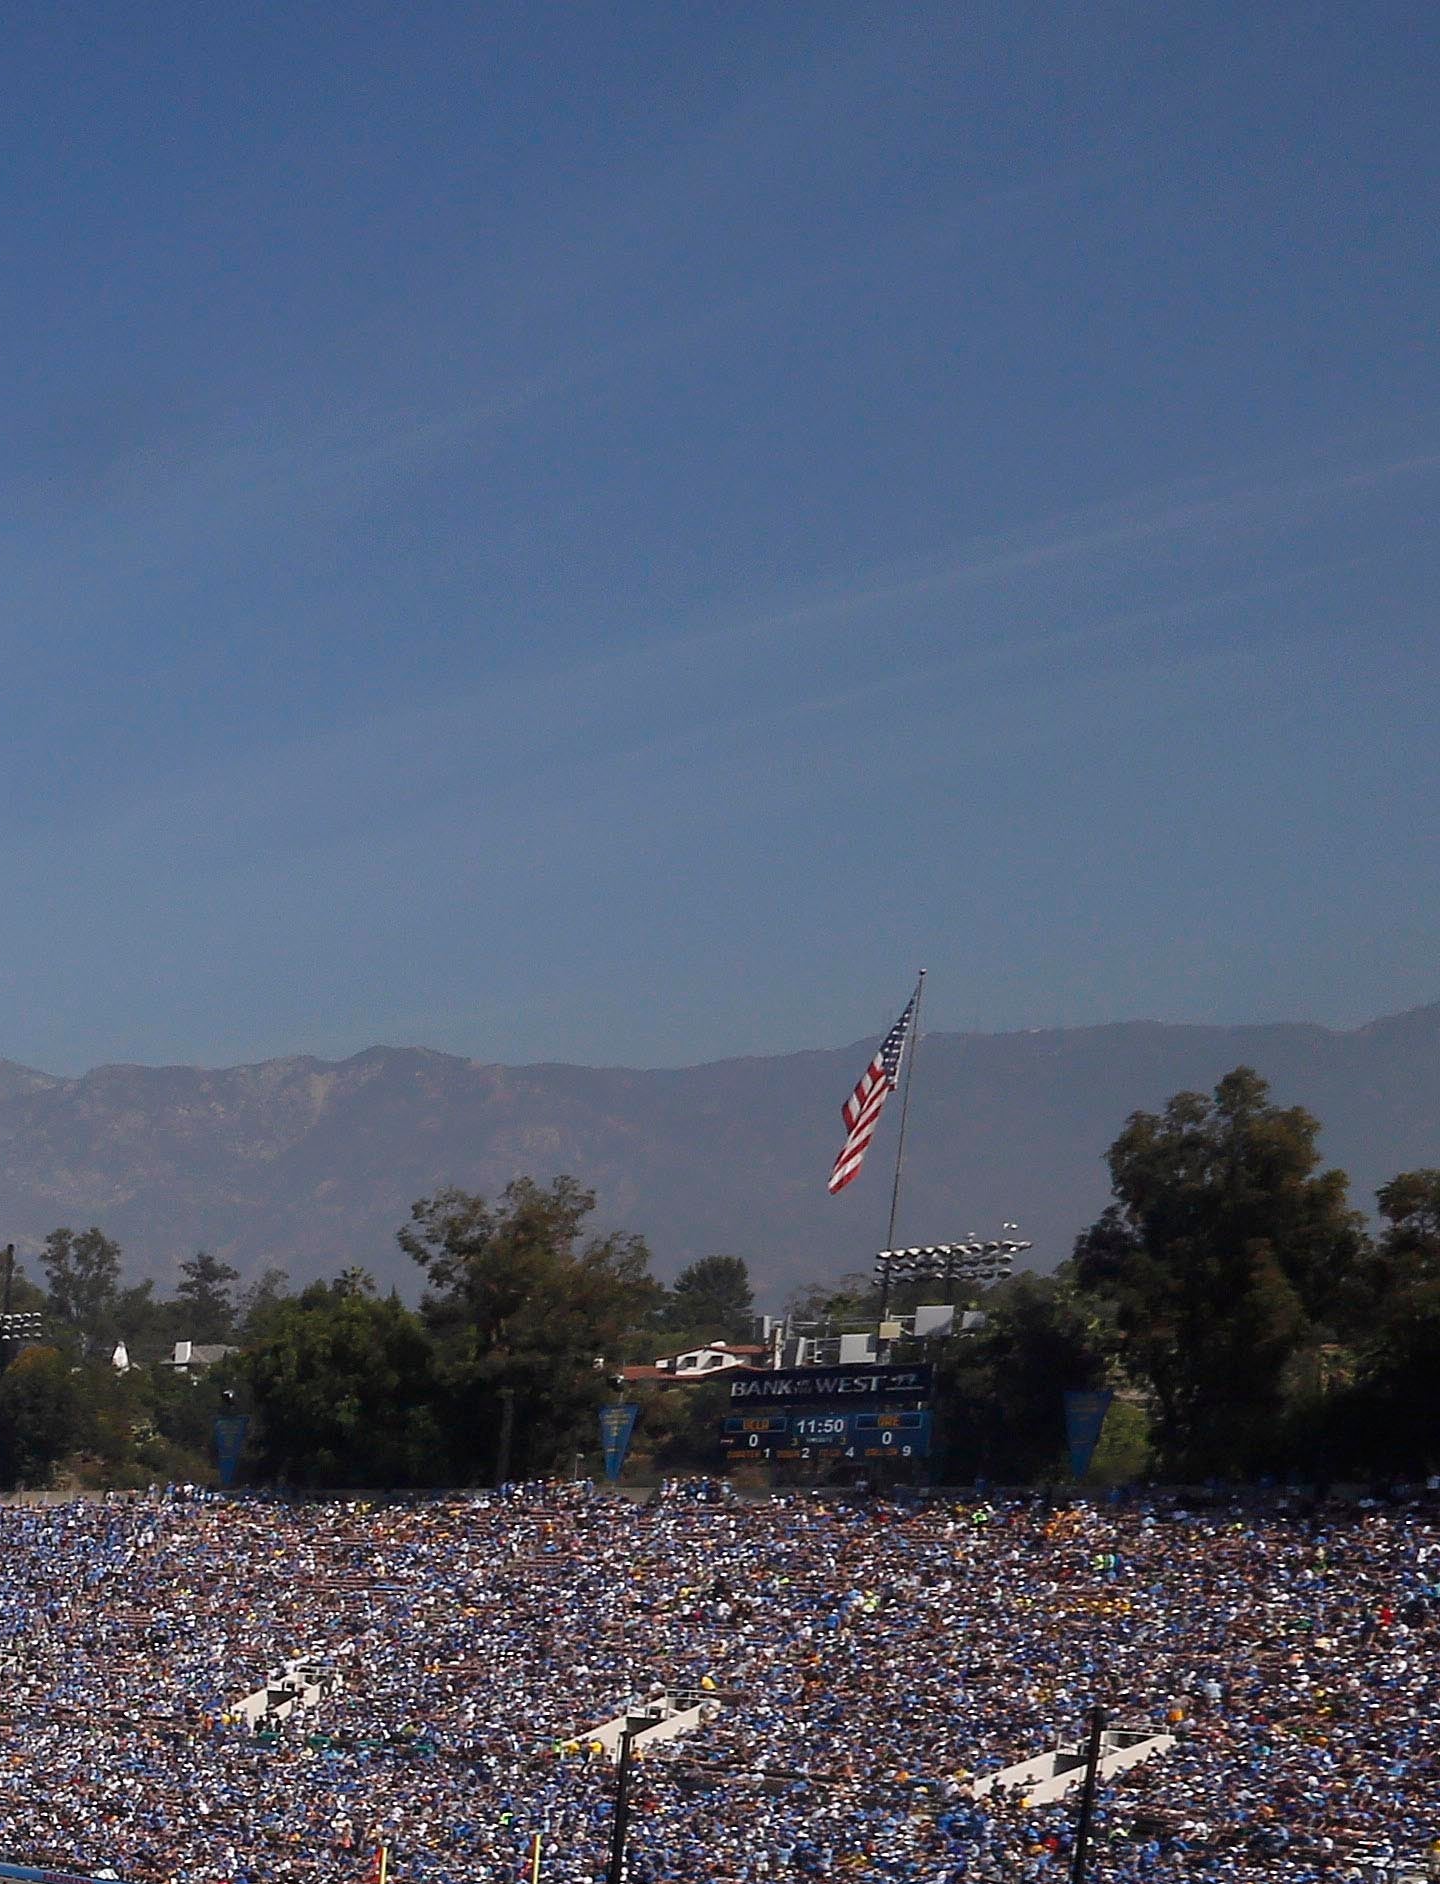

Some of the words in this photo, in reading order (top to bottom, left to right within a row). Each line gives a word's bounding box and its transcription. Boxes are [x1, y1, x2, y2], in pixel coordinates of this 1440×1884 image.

[730, 1379, 795, 1397] BANK
[815, 1375, 888, 1393] WEST
[797, 1418, 845, 1434] 11:50
[748, 1433, 759, 1448] 0
[882, 1430, 892, 1445] 0
[801, 1447, 811, 1459] 2
[844, 1446, 855, 1459] 4
[902, 1444, 912, 1457] 9
